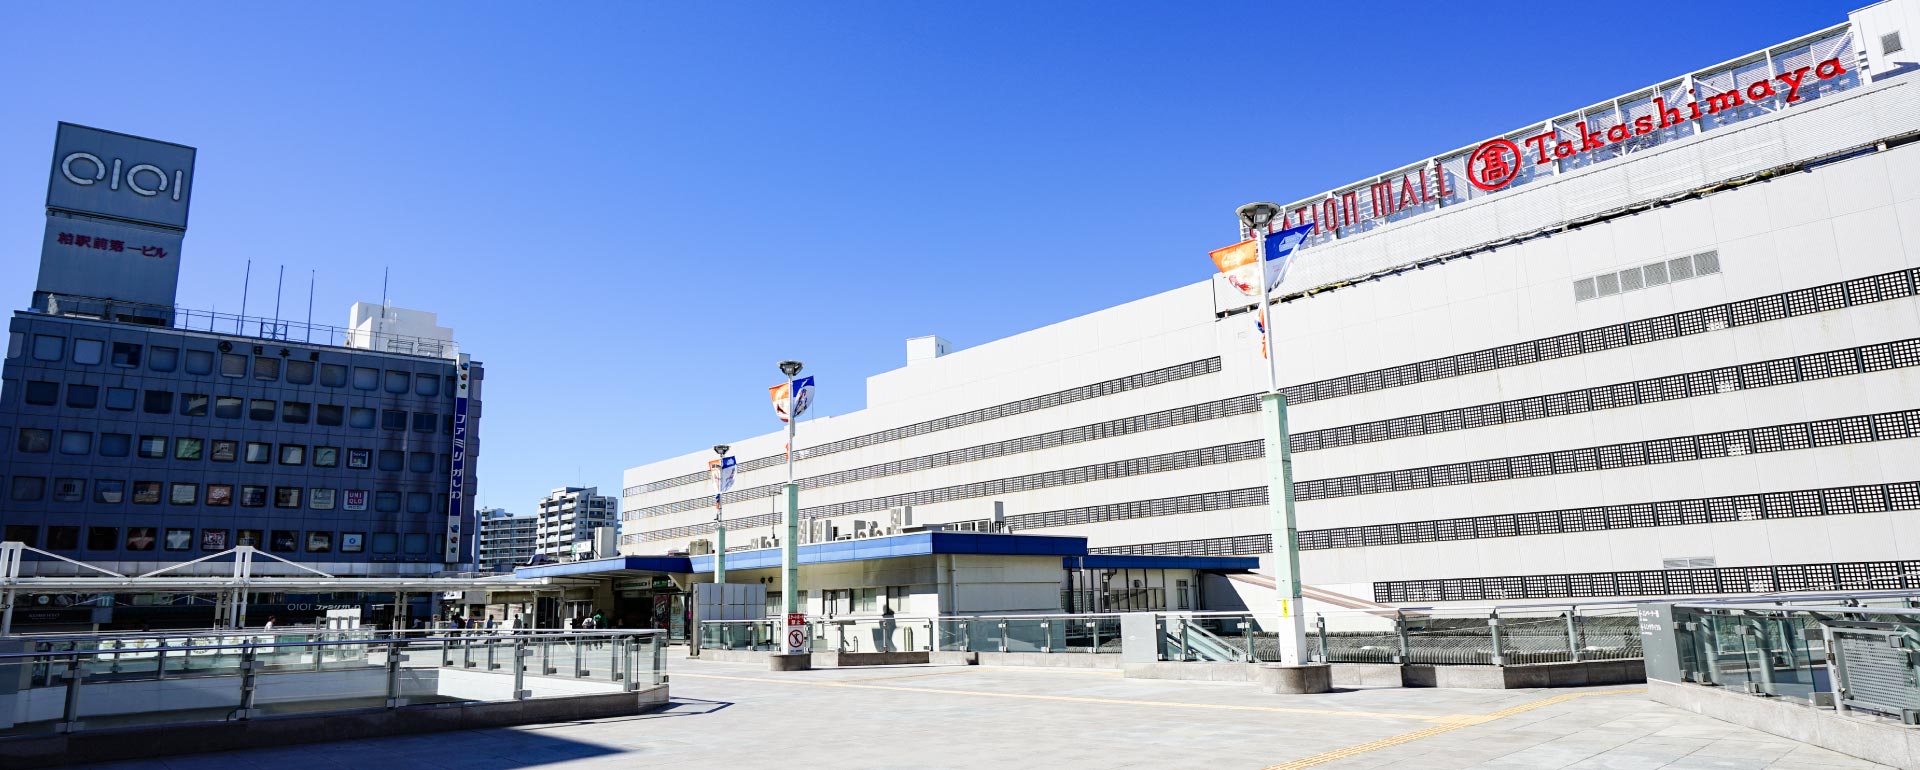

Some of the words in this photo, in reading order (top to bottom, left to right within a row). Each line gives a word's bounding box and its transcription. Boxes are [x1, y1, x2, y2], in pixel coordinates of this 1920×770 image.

[1370, 163, 1454, 217] MALL
[1525, 57, 1846, 165] Takashimaya
[57, 232, 168, 259] 柏駅前第一ビル
